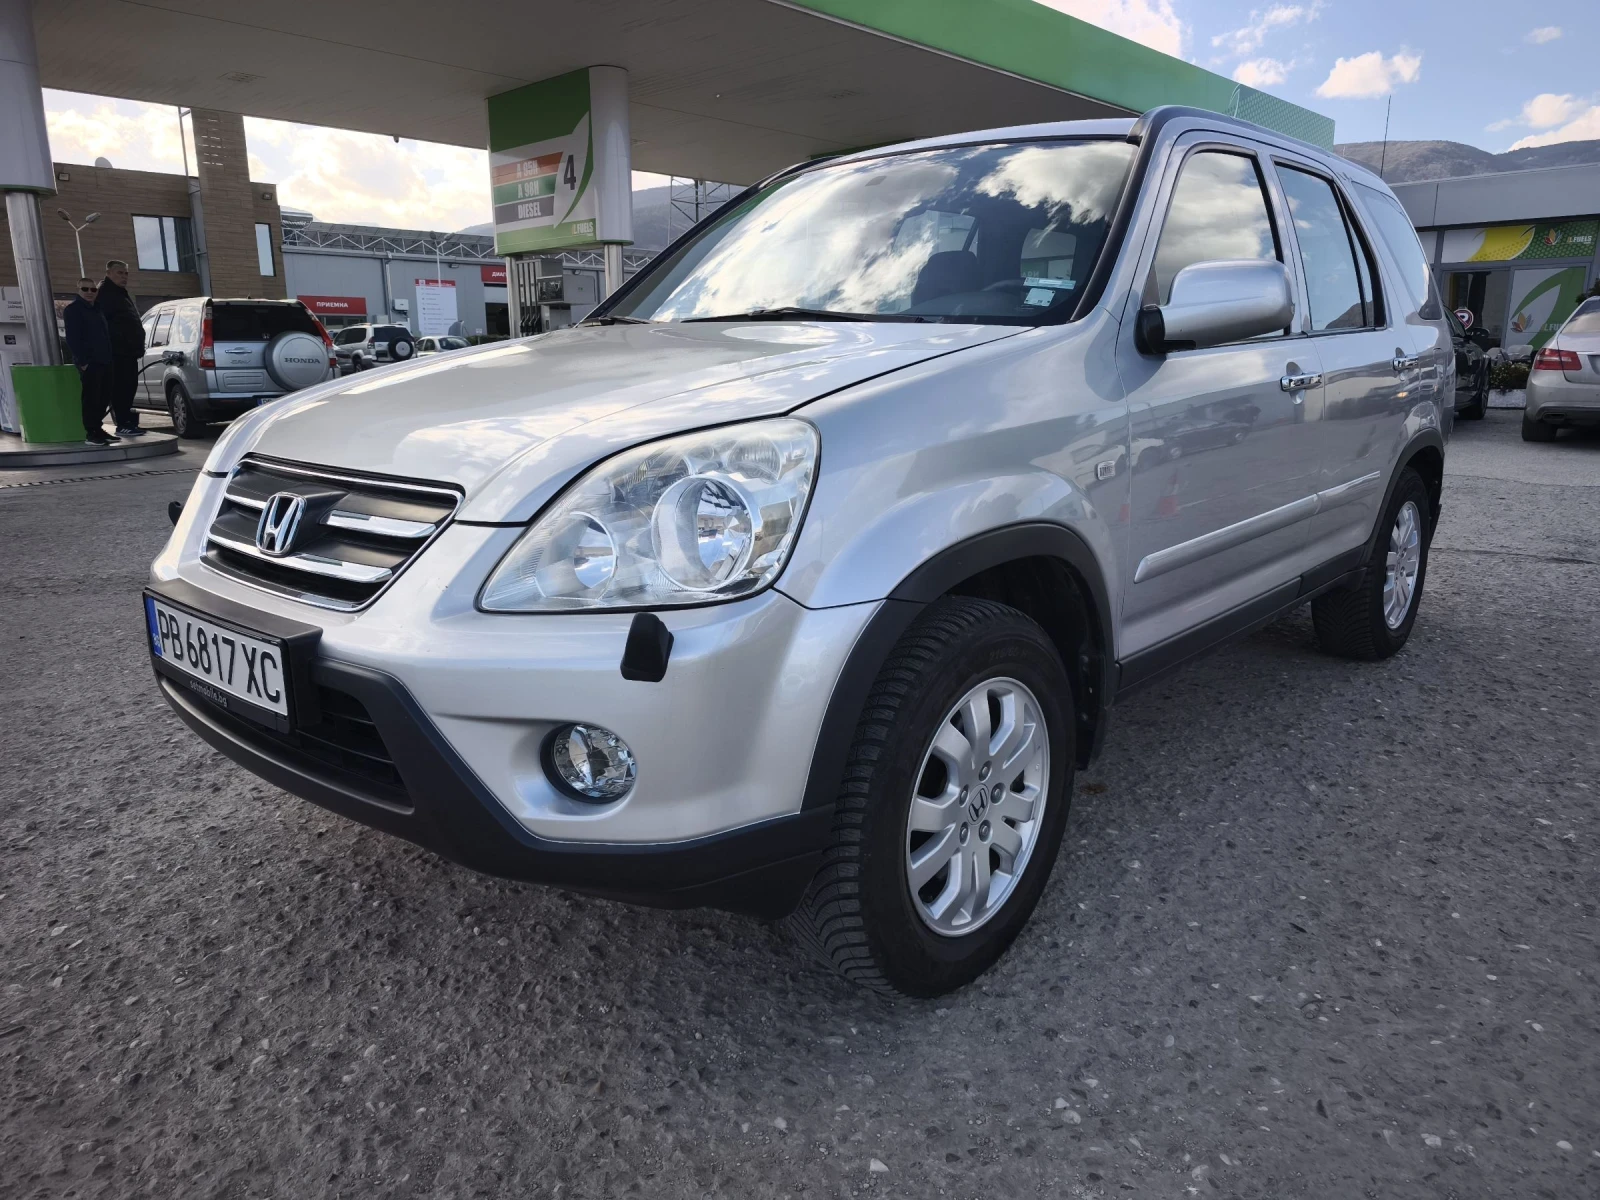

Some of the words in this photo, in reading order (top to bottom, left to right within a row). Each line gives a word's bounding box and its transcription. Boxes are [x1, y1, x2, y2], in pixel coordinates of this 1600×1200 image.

[516, 163, 522, 179] A
[563, 154, 577, 191] 4
[517, 183, 523, 199] A
[524, 180, 540, 197] 98H
[517, 201, 542, 219] DIESEL
[157, 608, 184, 661] PB
[186, 620, 236, 685] 6817
[241, 642, 281, 703] XC
